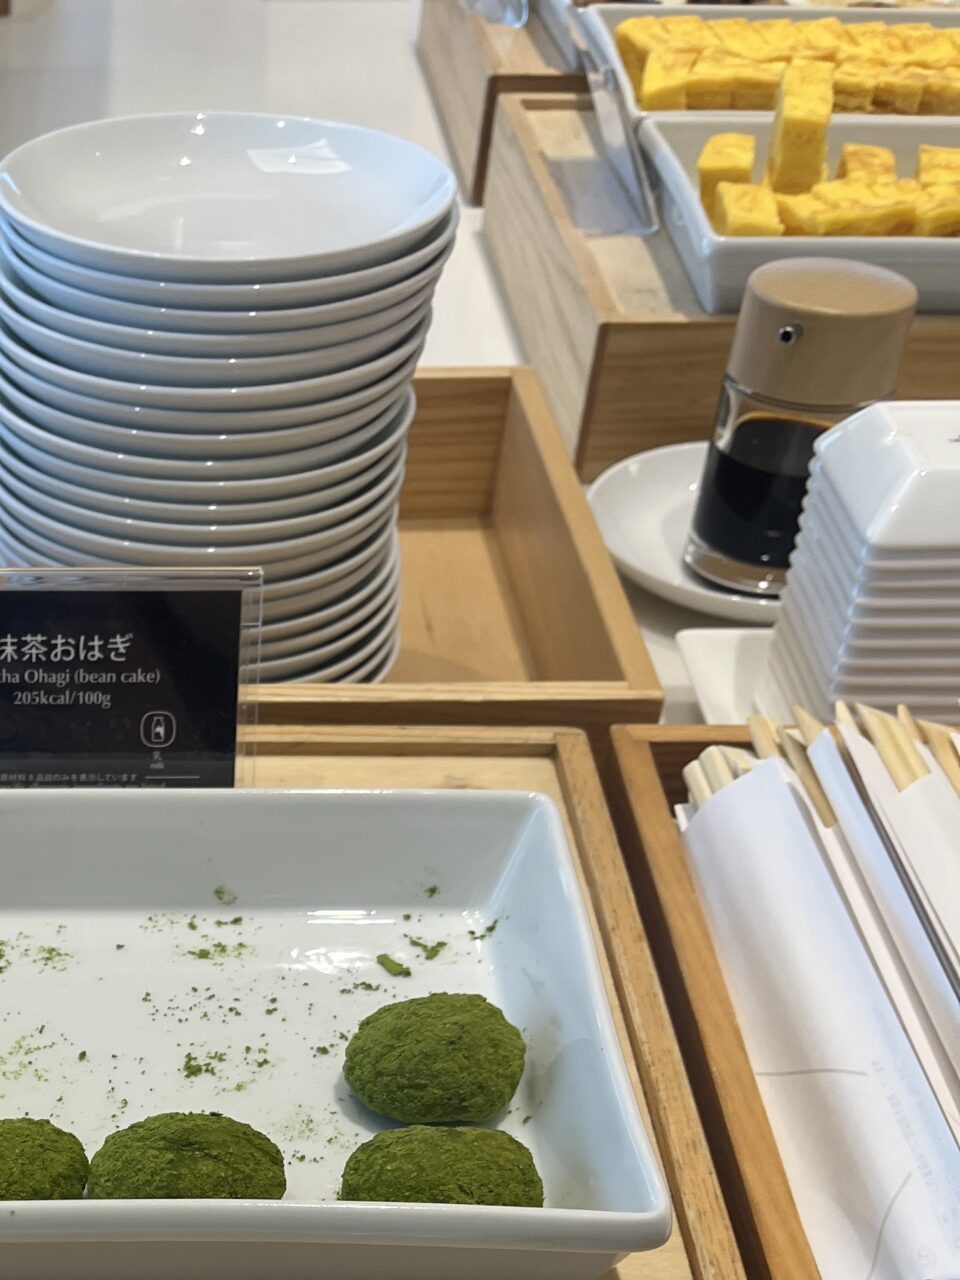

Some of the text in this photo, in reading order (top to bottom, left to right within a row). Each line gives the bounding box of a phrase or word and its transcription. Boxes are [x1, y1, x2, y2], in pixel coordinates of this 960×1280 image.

[24, 668, 71, 688] Ohagi
[74, 668, 118, 684] (bean
[120, 668, 162, 684] cake)
[12, 690, 113, 709] 205kcal/100g
